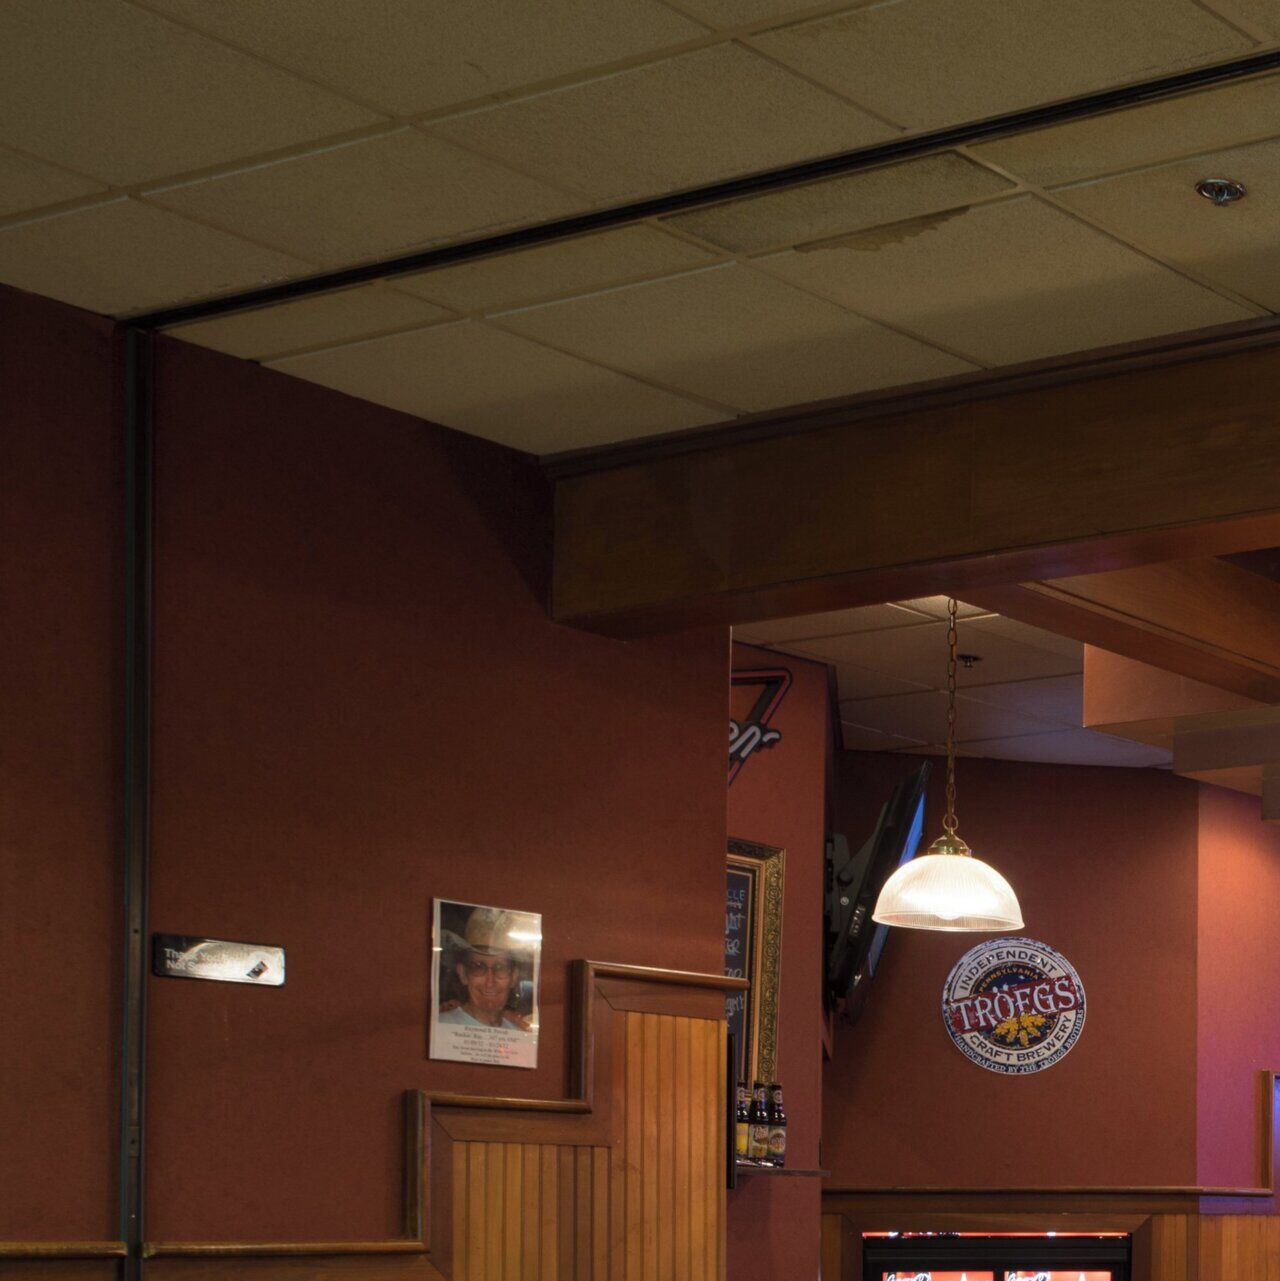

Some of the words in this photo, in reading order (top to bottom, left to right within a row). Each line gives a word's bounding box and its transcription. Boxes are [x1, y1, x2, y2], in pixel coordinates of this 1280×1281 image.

[959, 949, 1057, 991] INDEPENDENT
[978, 967, 1041, 993] PENNSYLVANIA
[970, 1034, 1014, 1062] CRAFT
[1017, 1015, 1072, 1062] BREWERY
